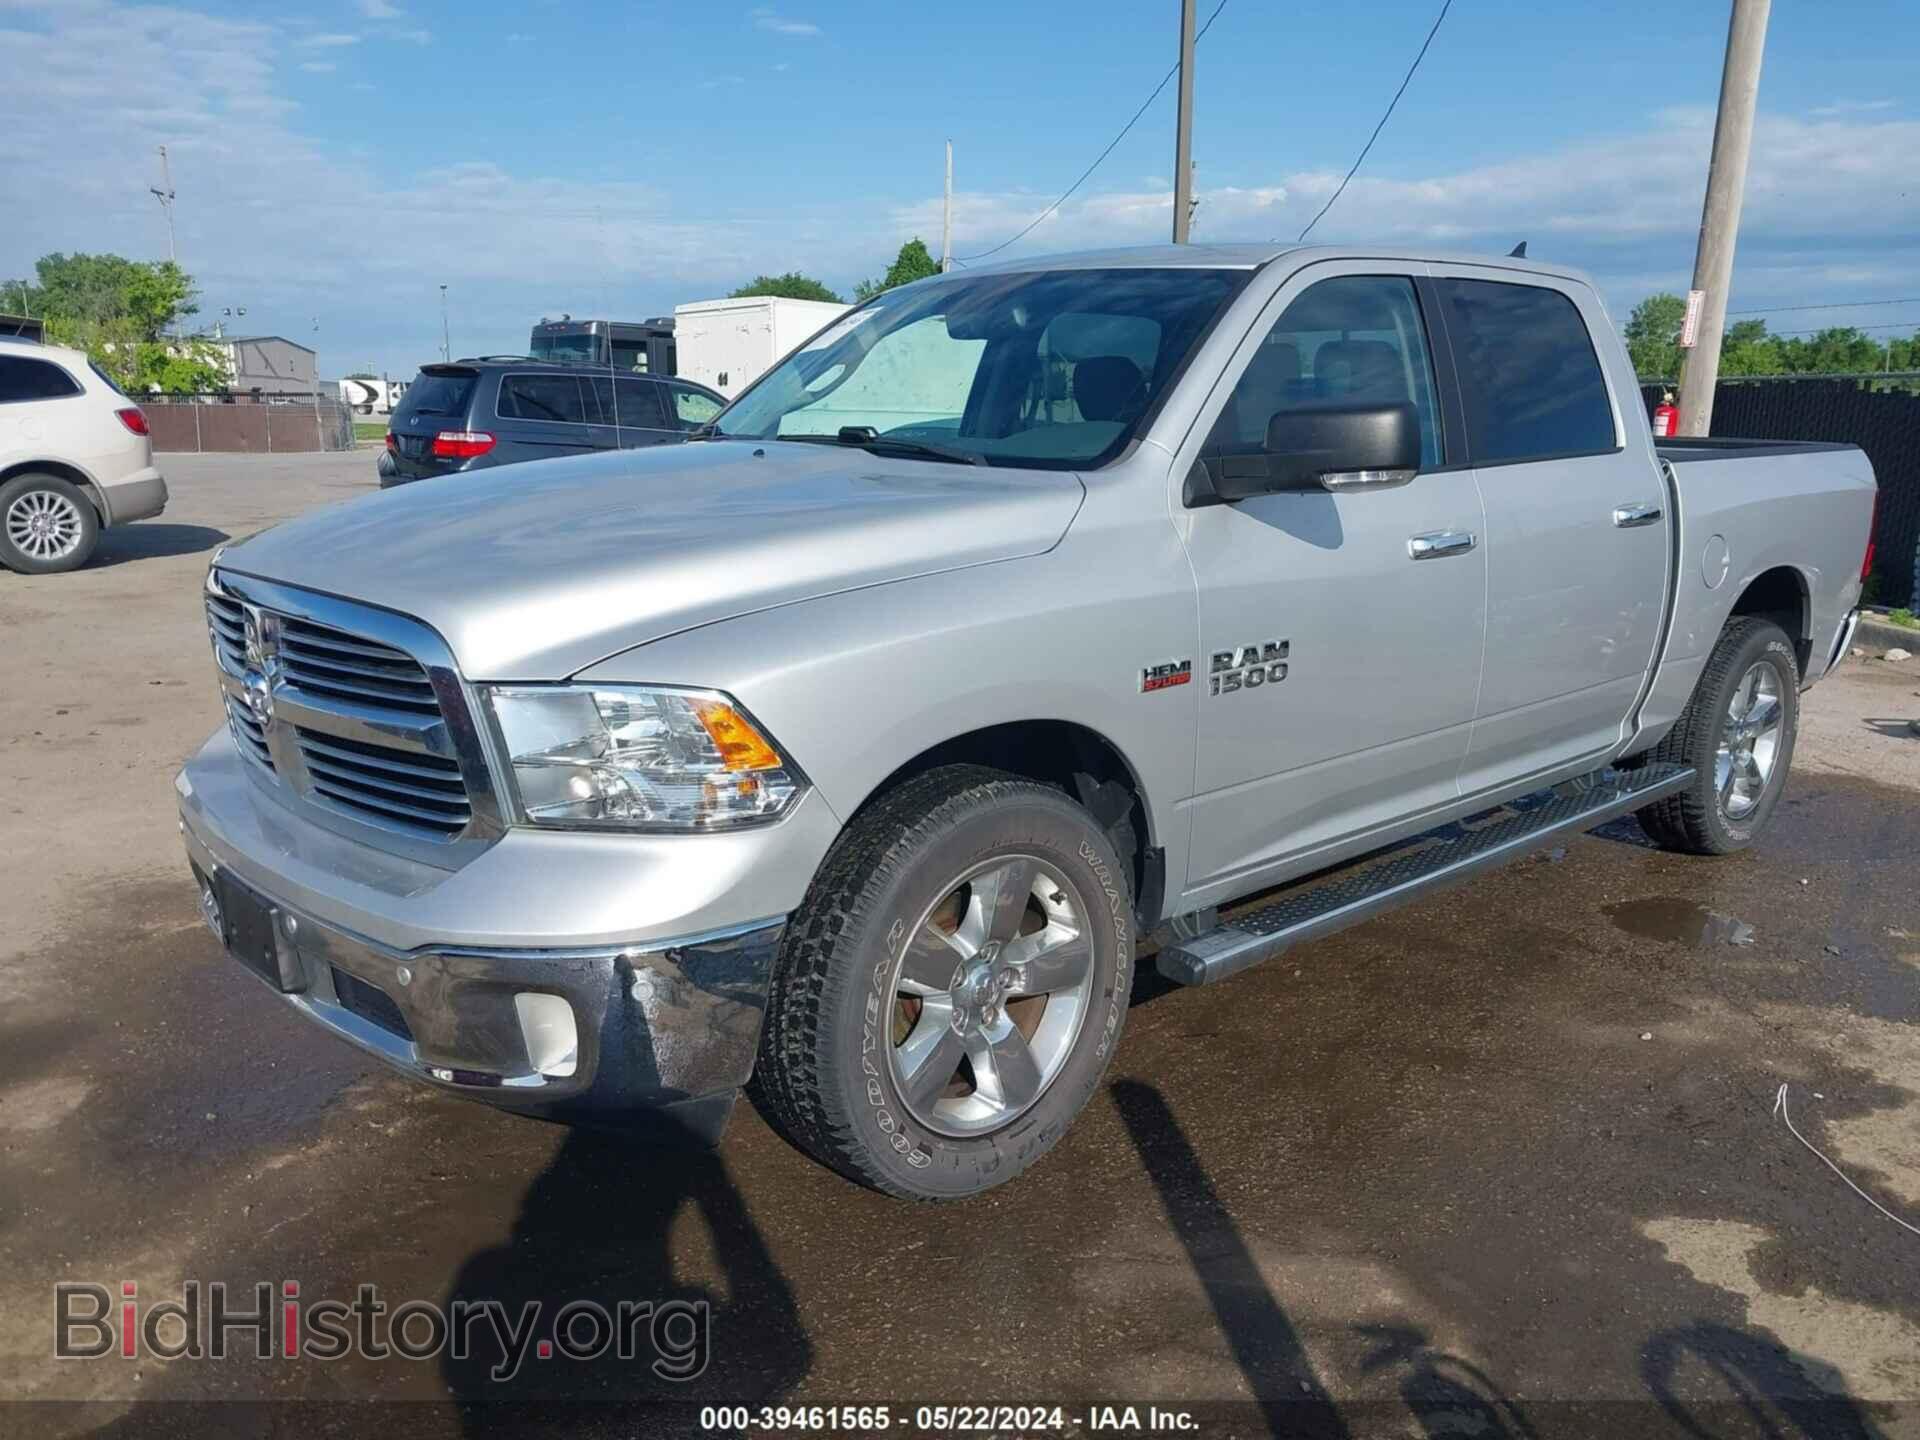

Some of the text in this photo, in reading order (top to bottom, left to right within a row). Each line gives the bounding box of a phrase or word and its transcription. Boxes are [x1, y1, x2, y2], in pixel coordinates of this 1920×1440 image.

[1143, 660, 1191, 679] HEMI
[1210, 639, 1290, 673] RAM
[1208, 662, 1289, 697] 1500
[1078, 839, 1128, 1058] WRANGLER
[862, 918, 933, 1169] GOODYEAR
